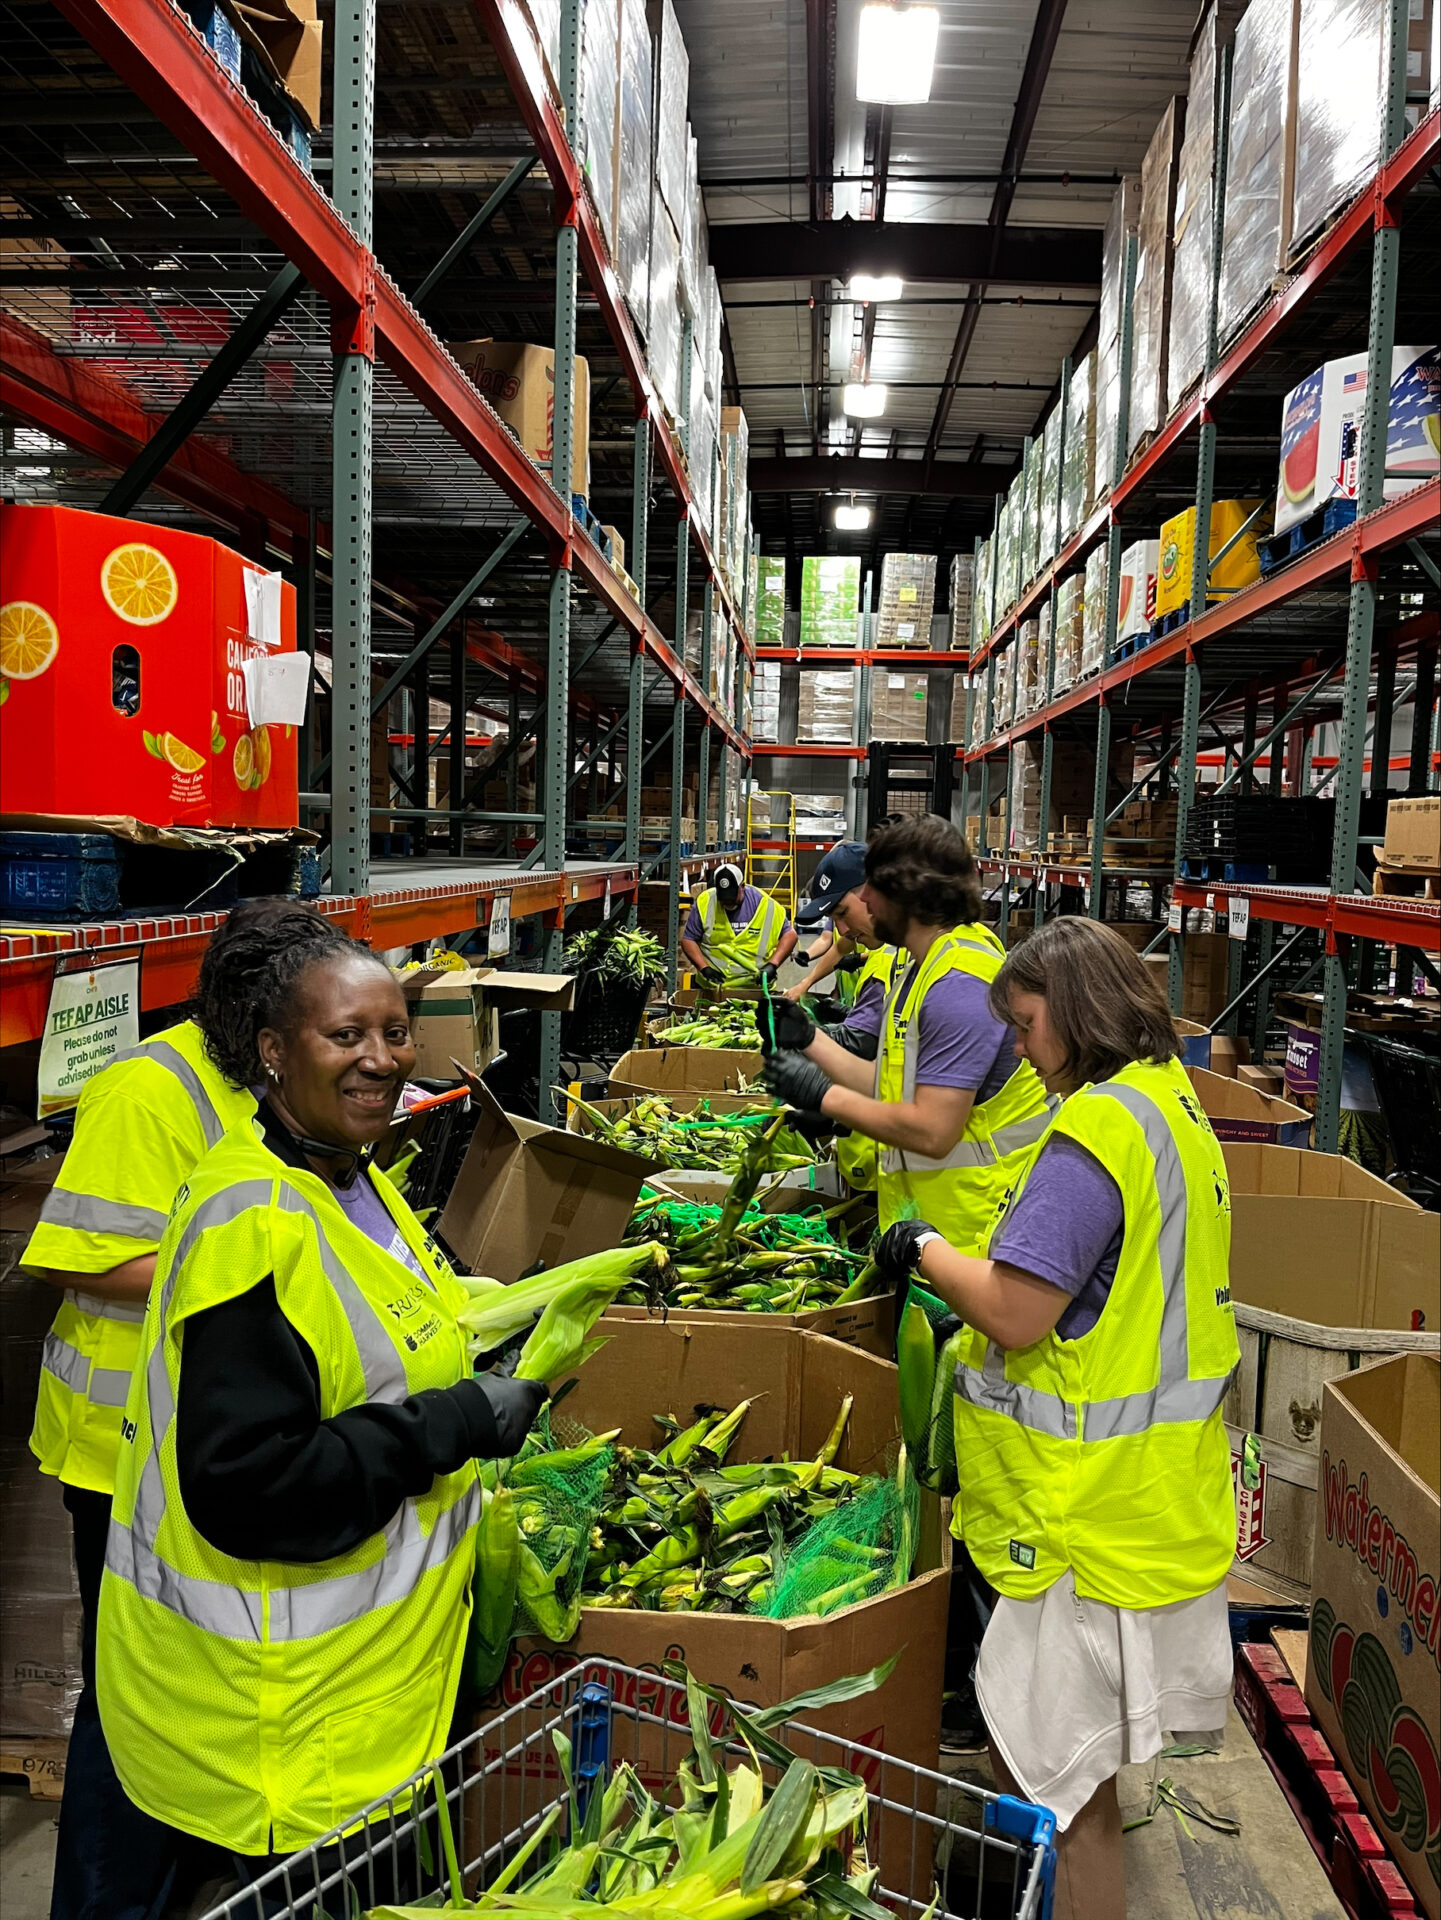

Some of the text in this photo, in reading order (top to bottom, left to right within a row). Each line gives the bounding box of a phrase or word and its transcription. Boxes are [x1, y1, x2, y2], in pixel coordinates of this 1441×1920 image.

[52, 993, 129, 1031] TEFAP AISLE
[64, 1025, 118, 1051] Please do not
[67, 1043, 116, 1071] grab unless
[57, 1063, 93, 1087] advised
[1238, 1511, 1248, 1542] STEP
